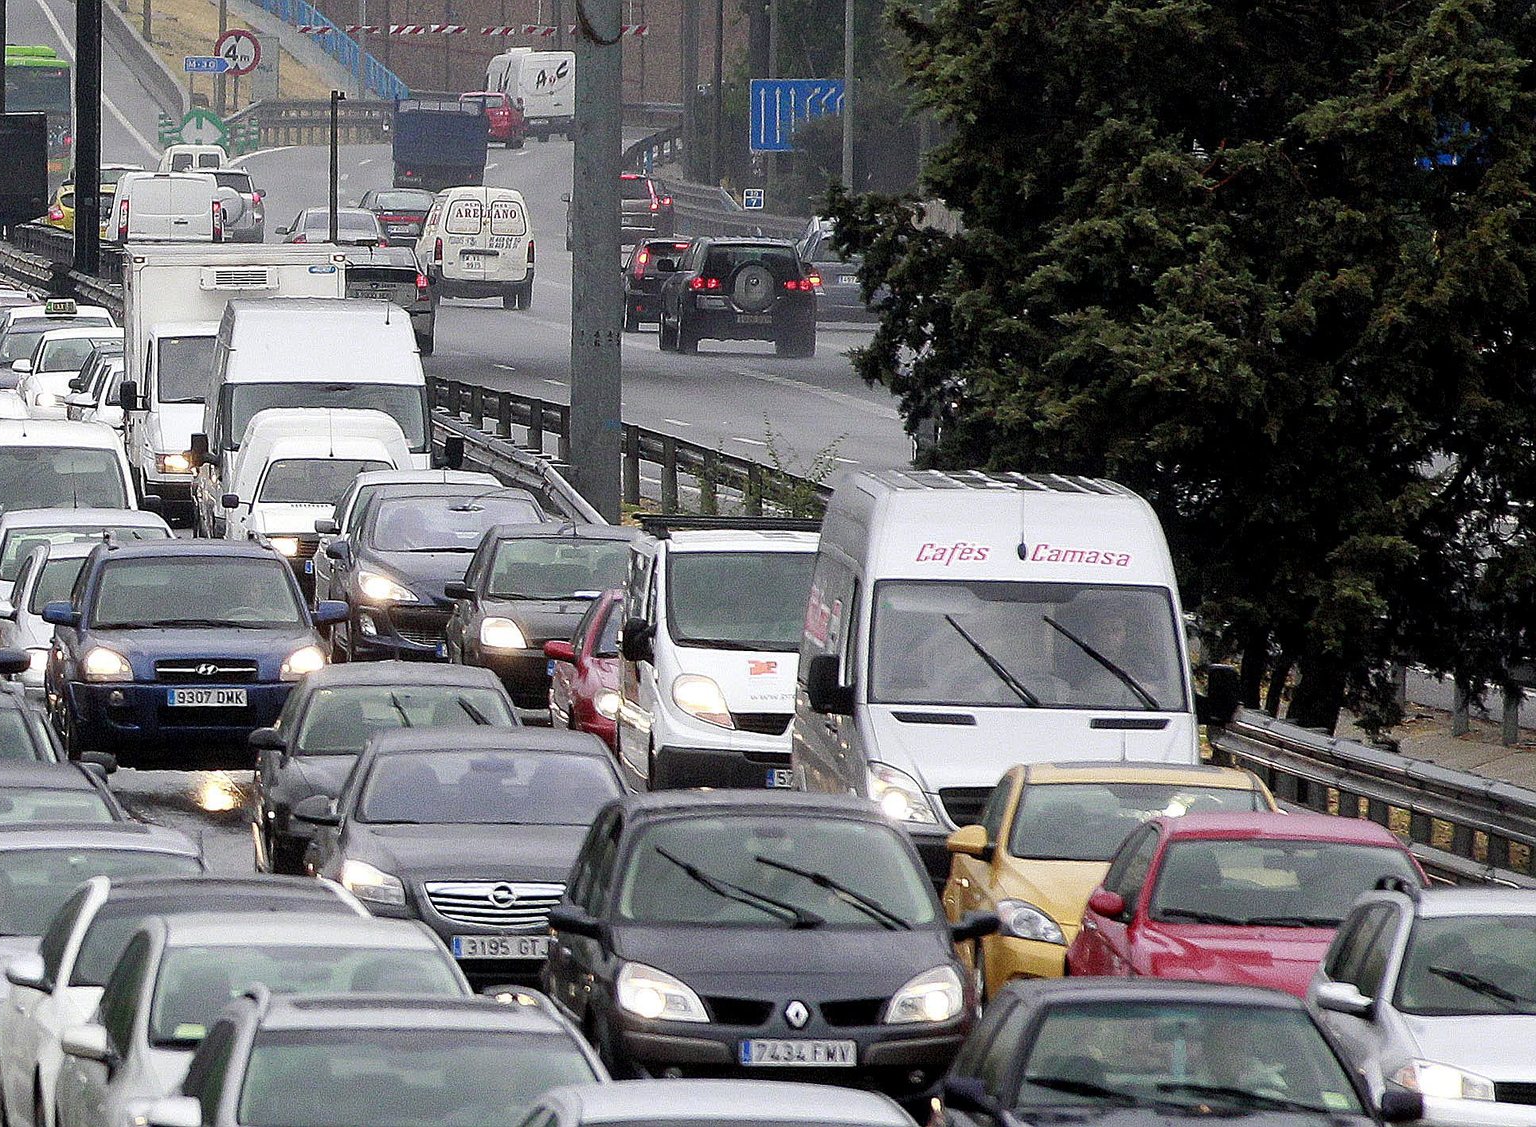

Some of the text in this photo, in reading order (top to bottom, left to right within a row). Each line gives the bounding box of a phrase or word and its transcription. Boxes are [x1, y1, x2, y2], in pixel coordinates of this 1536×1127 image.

[455, 208, 517, 219] ARELLANO
[916, 543, 1130, 567] Cafés Camasa
[177, 691, 243, 704] 9307 DMK
[467, 939, 510, 956] 3195
[757, 1042, 806, 1062] 7434
